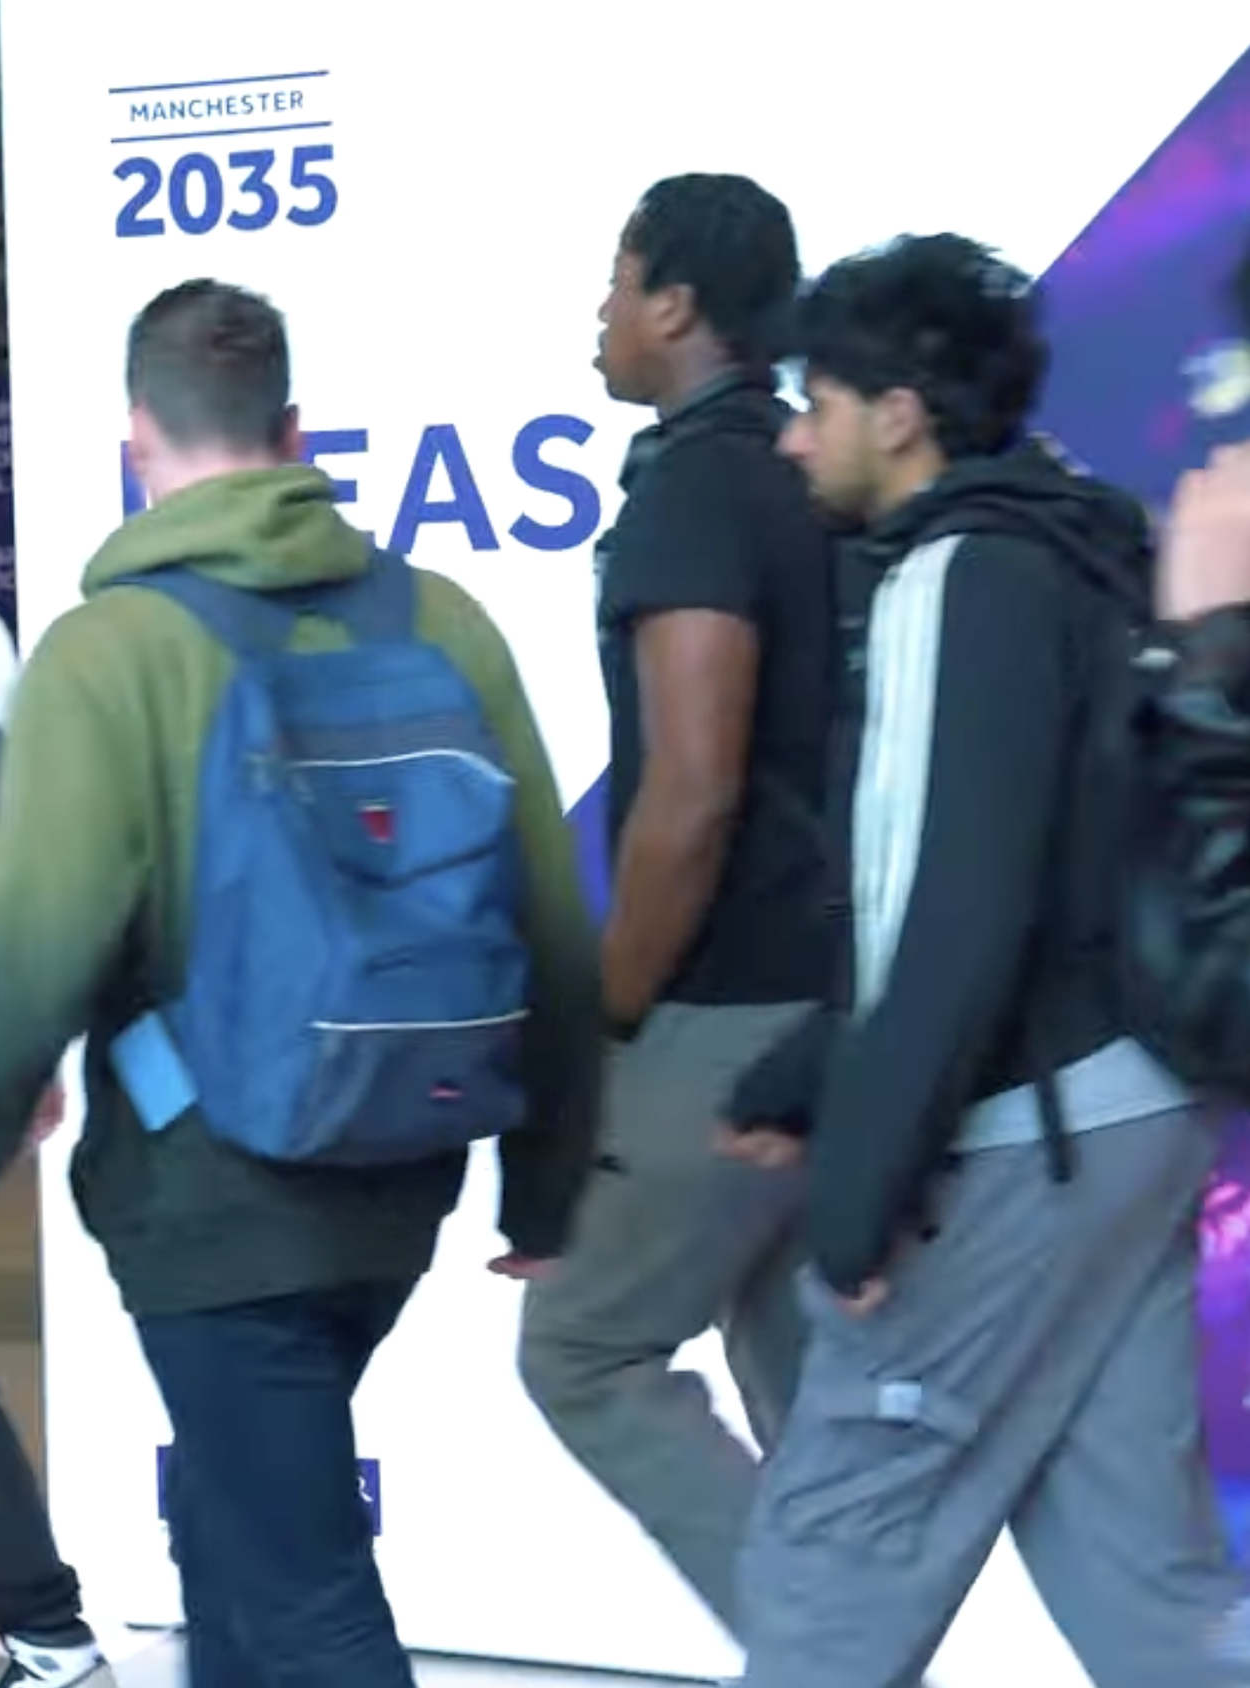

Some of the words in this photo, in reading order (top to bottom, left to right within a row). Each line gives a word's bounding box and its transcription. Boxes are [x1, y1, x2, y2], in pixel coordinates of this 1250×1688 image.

[130, 90, 305, 122] MANCHESTER
[112, 143, 339, 238] 2035
[121, 413, 602, 555] EAS
